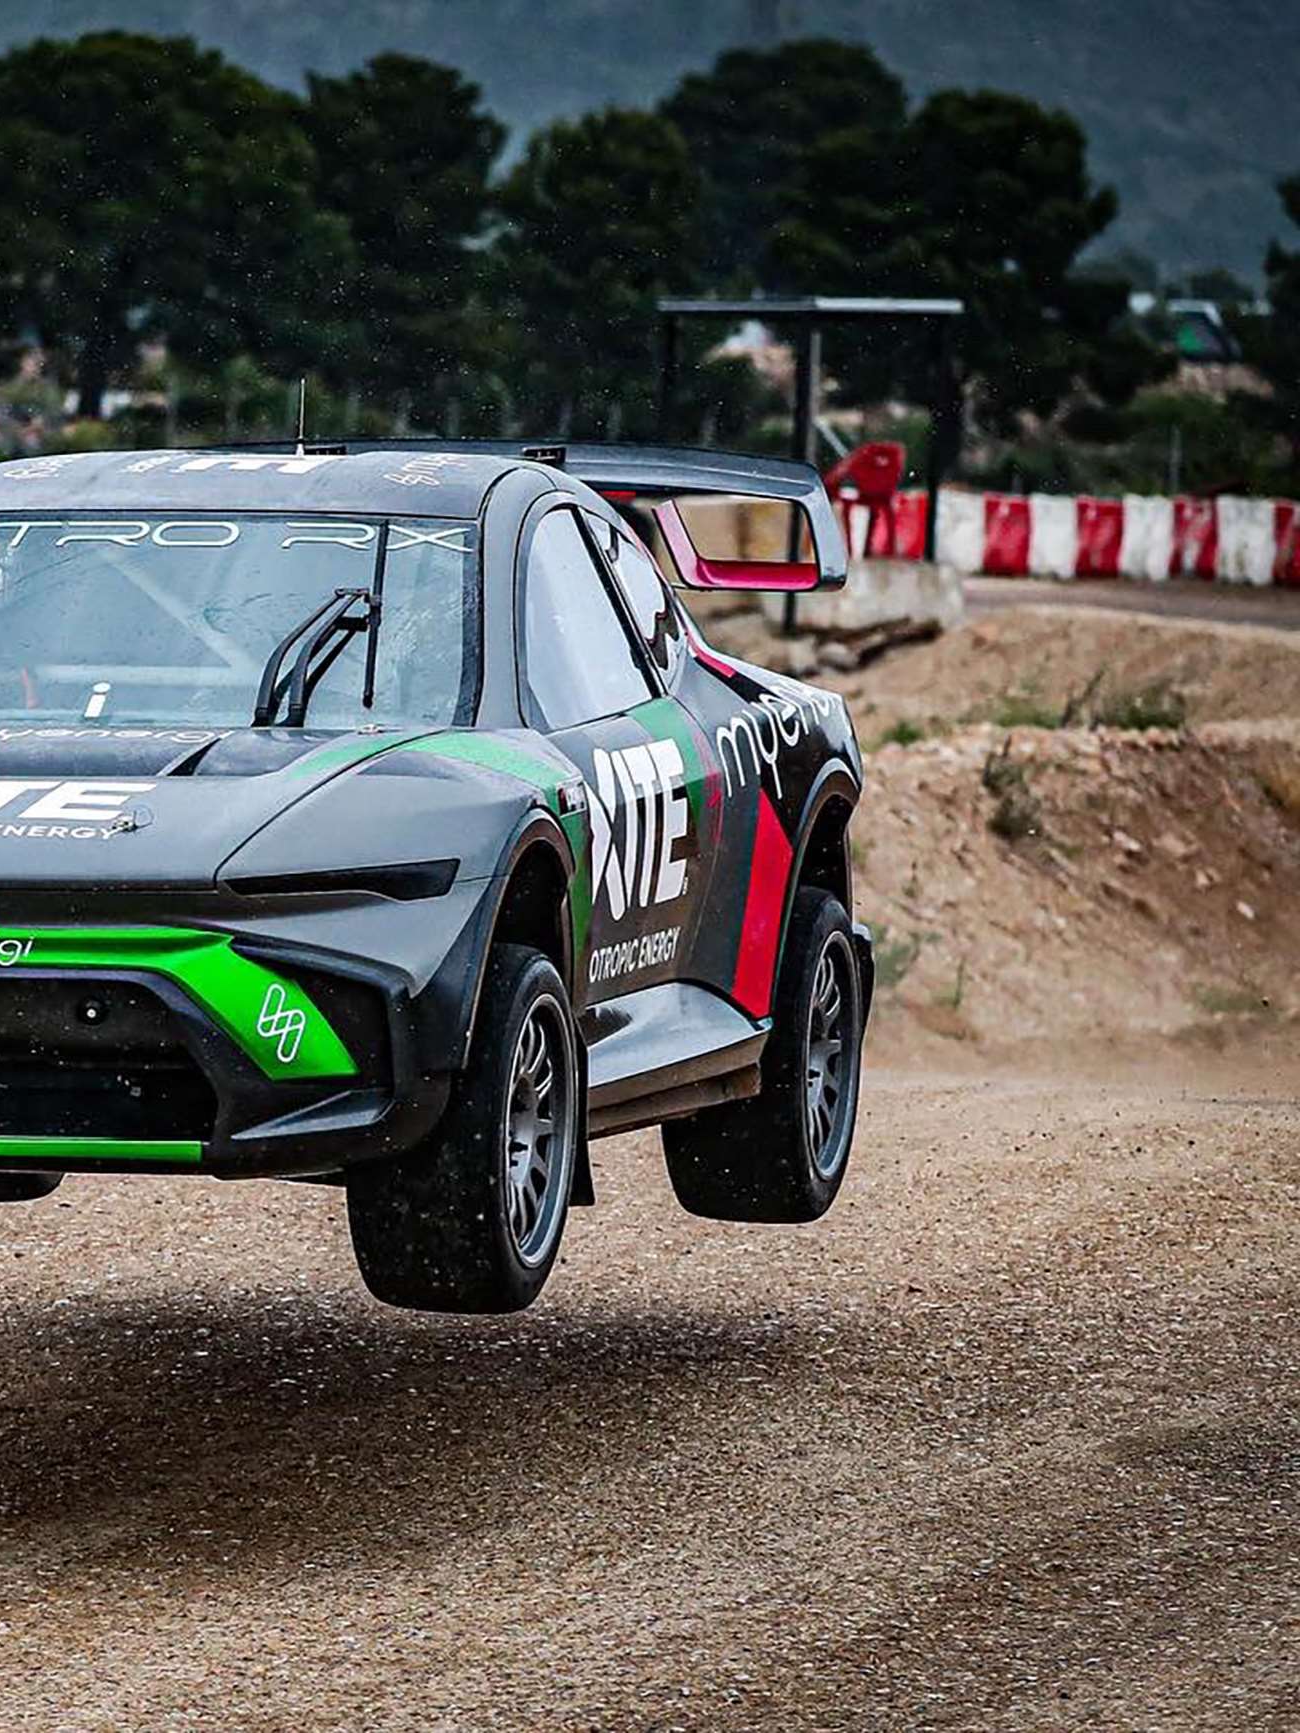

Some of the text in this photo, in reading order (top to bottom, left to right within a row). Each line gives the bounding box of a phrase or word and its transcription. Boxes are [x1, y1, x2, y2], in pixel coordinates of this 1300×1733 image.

[282, 522, 474, 552] RX
[583, 738, 688, 921] XITE
[638, 926, 681, 969] ENERGY
